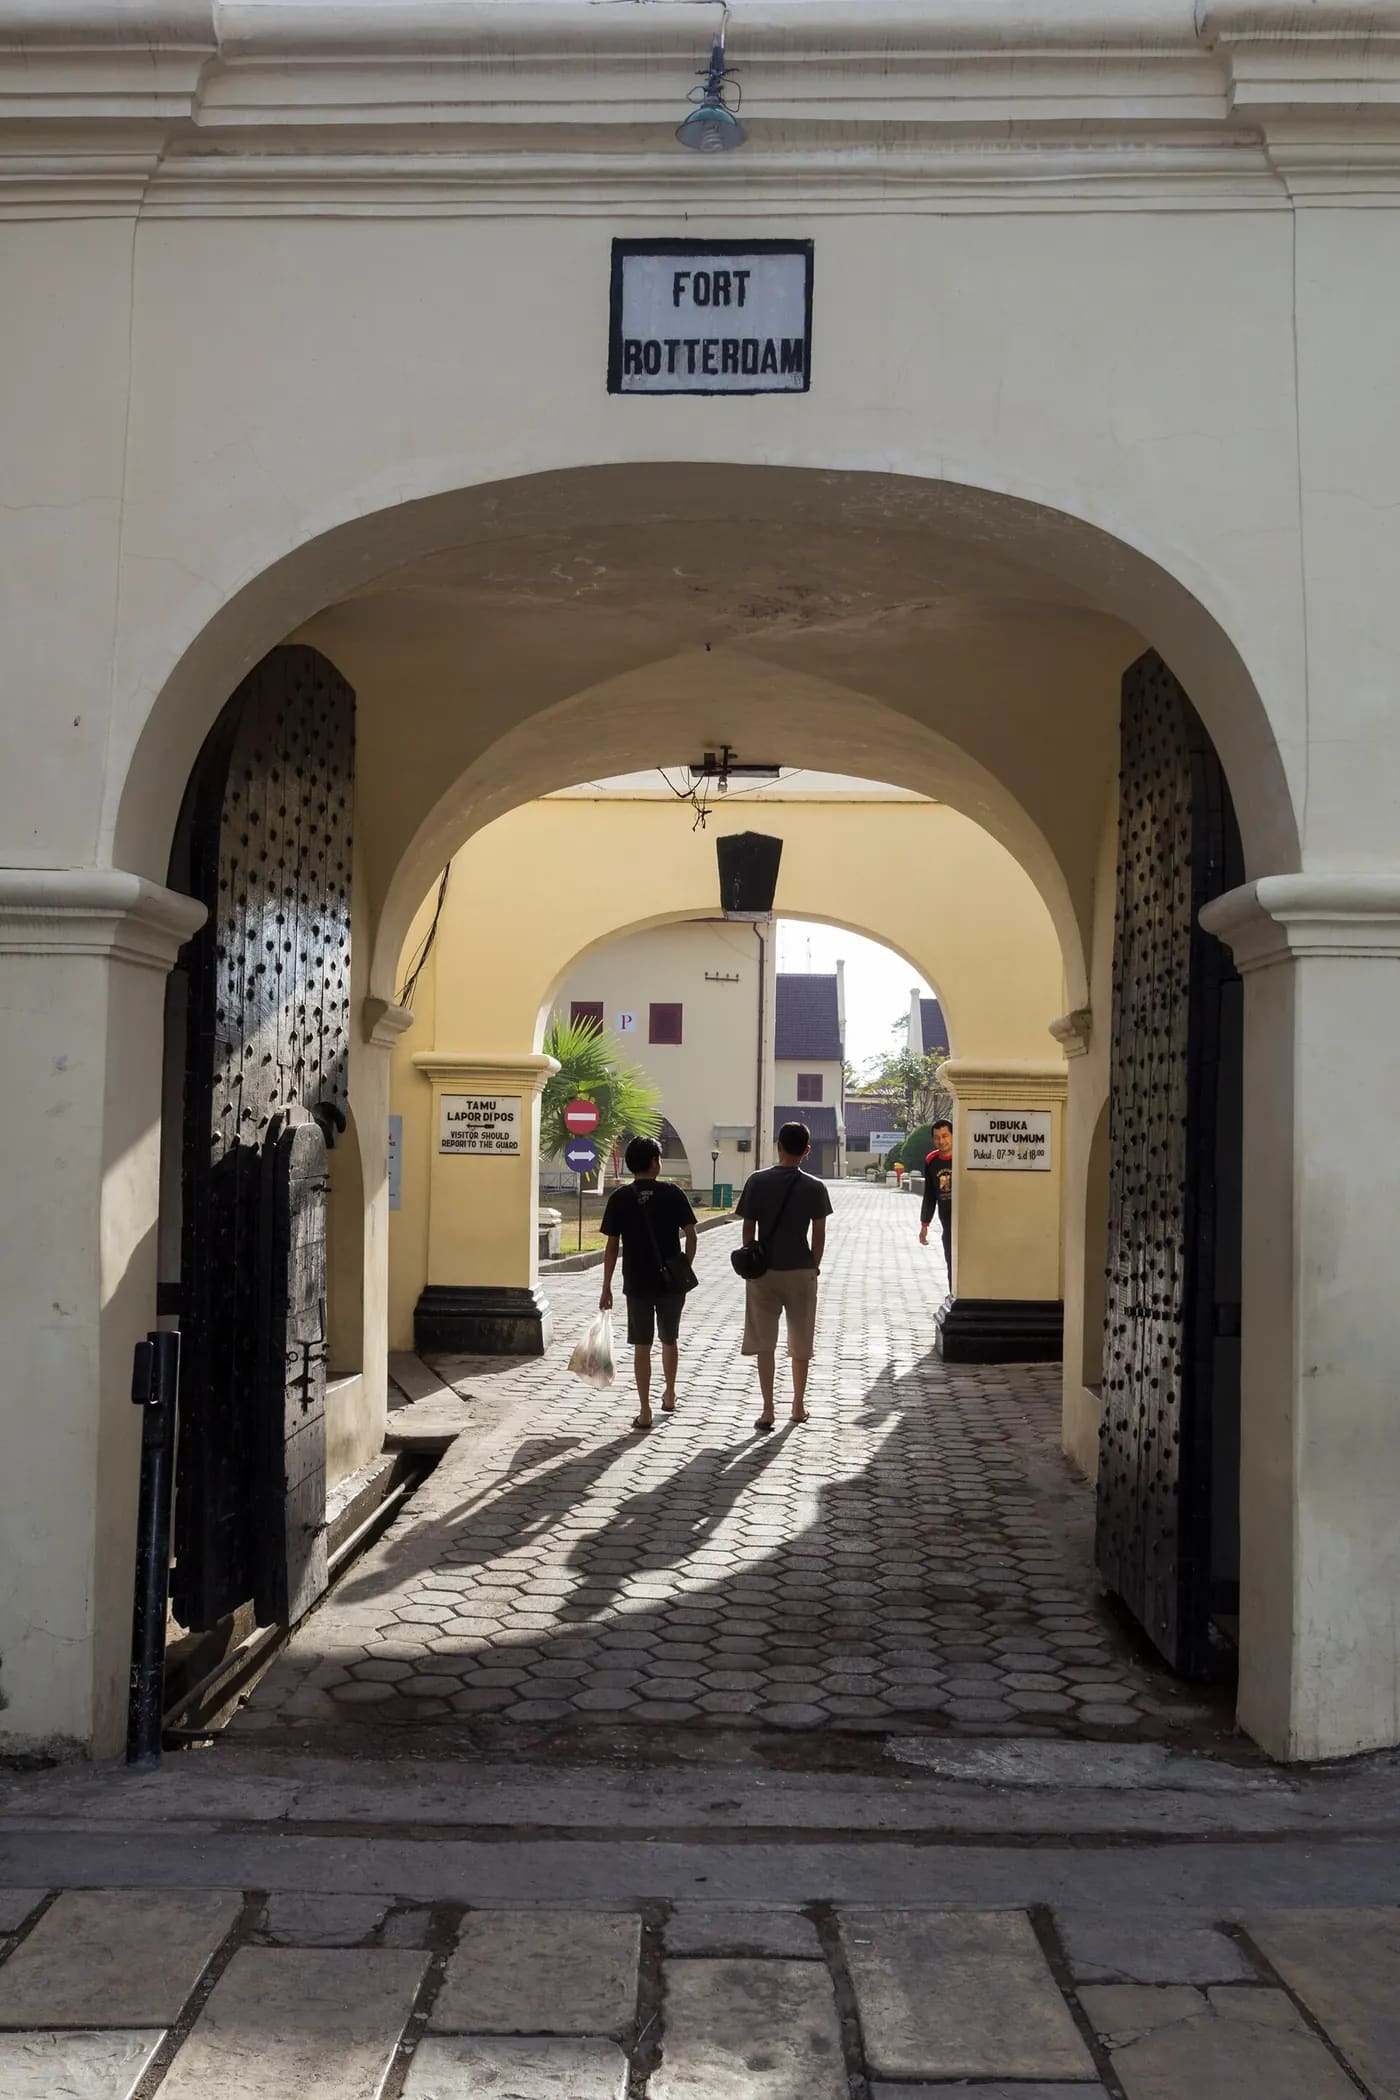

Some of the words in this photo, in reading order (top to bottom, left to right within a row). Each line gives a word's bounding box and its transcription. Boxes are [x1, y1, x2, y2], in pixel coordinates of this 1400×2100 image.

[673, 270, 750, 307] FORT
[624, 338, 804, 375] ROTTERDAM
[621, 1014, 632, 1030] P
[466, 1101, 496, 1110] TAMU
[447, 1112, 481, 1121] LAPOR
[483, 1112, 493, 1121] DI
[494, 1113, 514, 1121] POS
[990, 1121, 1027, 1130] DIBUKA
[450, 1131, 479, 1139] VISITOR
[481, 1132, 510, 1140] SHOULD
[974, 1134, 1009, 1143] UNTUK
[1012, 1134, 1045, 1143] UMUM
[468, 1140, 477, 1148] TO
